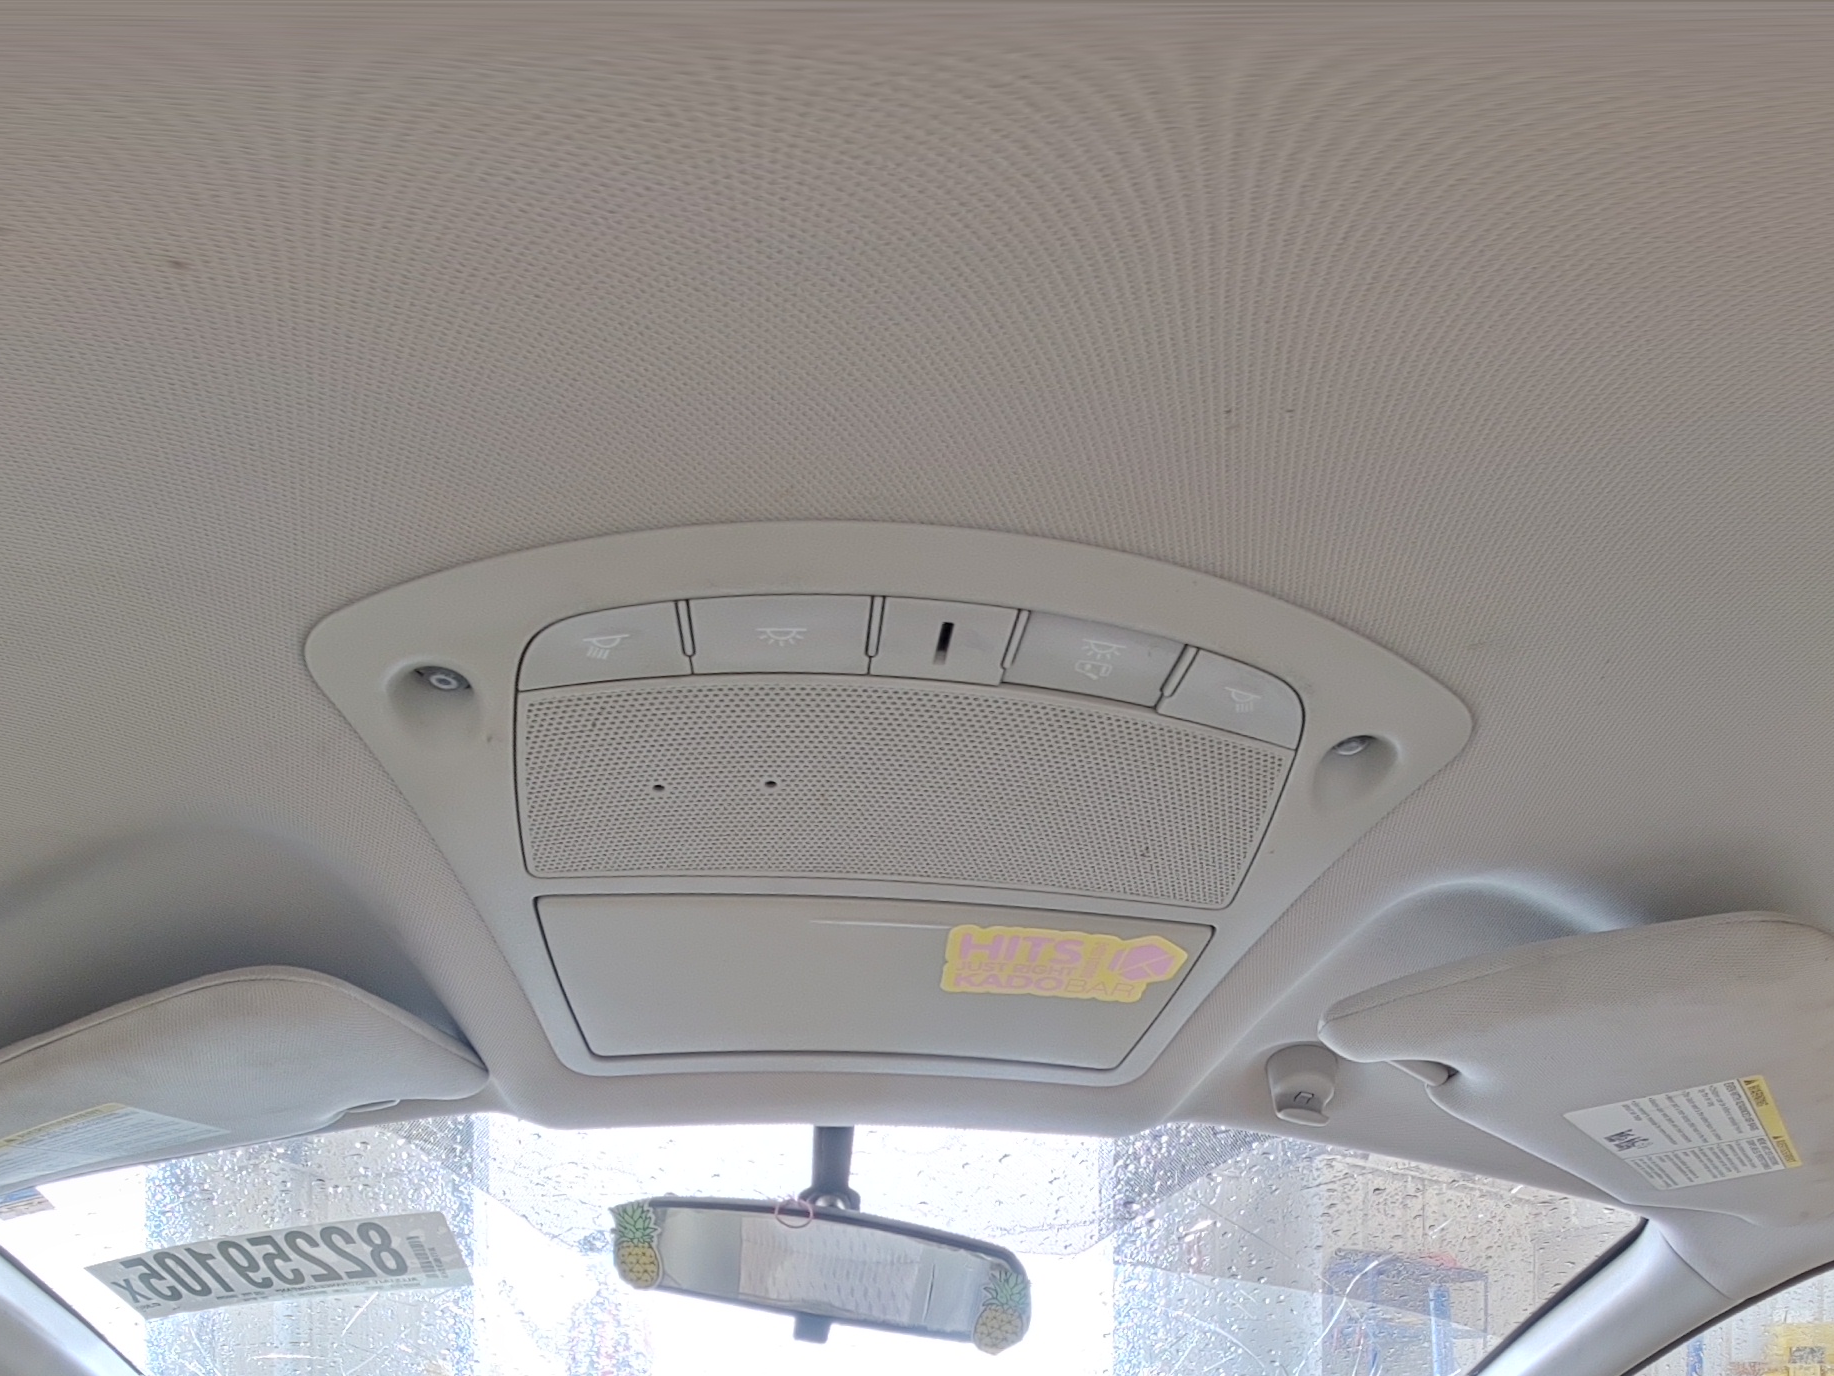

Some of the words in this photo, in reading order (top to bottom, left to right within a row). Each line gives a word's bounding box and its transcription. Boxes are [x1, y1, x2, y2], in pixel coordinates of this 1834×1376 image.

[960, 933, 1083, 966] HITS
[955, 960, 1011, 973] JUST
[1015, 963, 1080, 978] RIGHT
